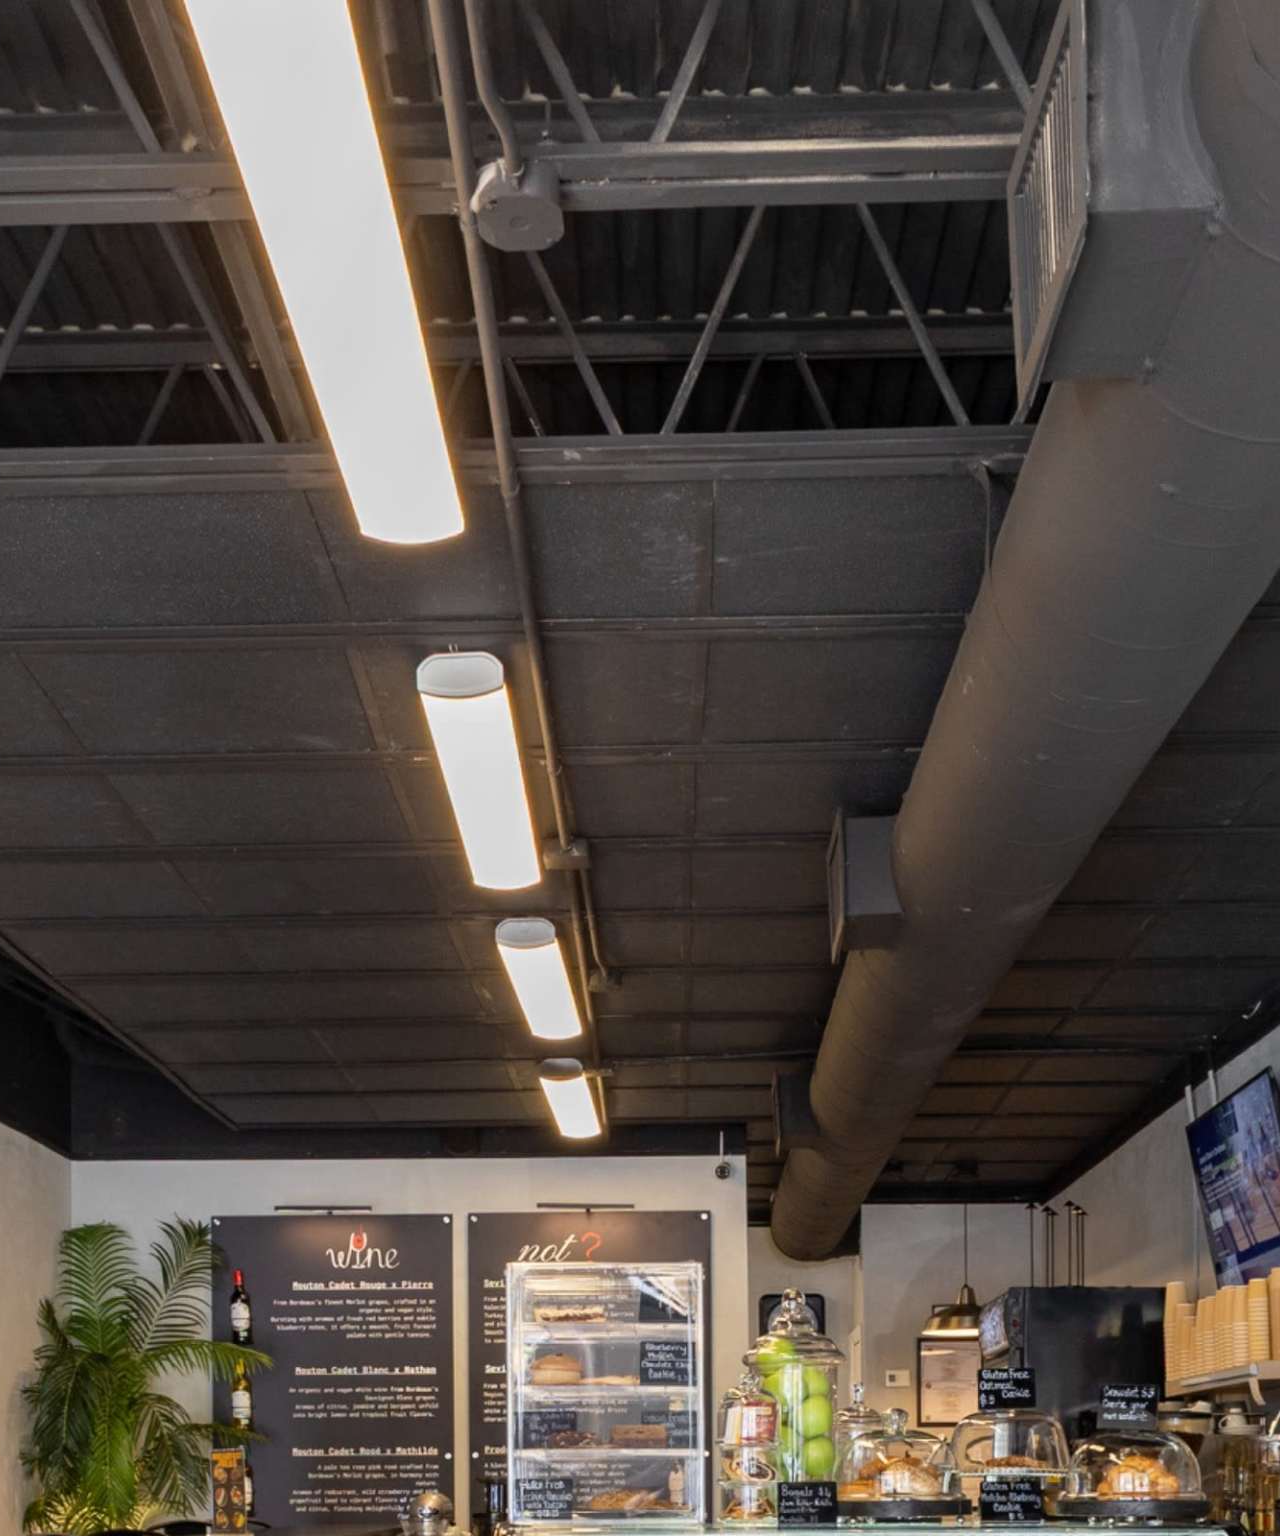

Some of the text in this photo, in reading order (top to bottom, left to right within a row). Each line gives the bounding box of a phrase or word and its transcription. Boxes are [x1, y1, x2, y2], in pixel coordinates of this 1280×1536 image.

[326, 1231, 400, 1269] wine
[518, 1234, 576, 1262] not
[292, 1281, 324, 1290] Mouton
[329, 1281, 355, 1290] Cadet
[360, 1281, 386, 1290] Rouge
[401, 1281, 434, 1290] Pierre
[295, 1366, 327, 1376] Mouton
[331, 1366, 358, 1375] Cadet
[362, 1366, 390, 1375] Blanc
[404, 1366, 437, 1375] Nathan
[292, 1448, 324, 1456] Mouton
[328, 1448, 355, 1456] Cadet
[396, 1447, 438, 1456] Mathilde
